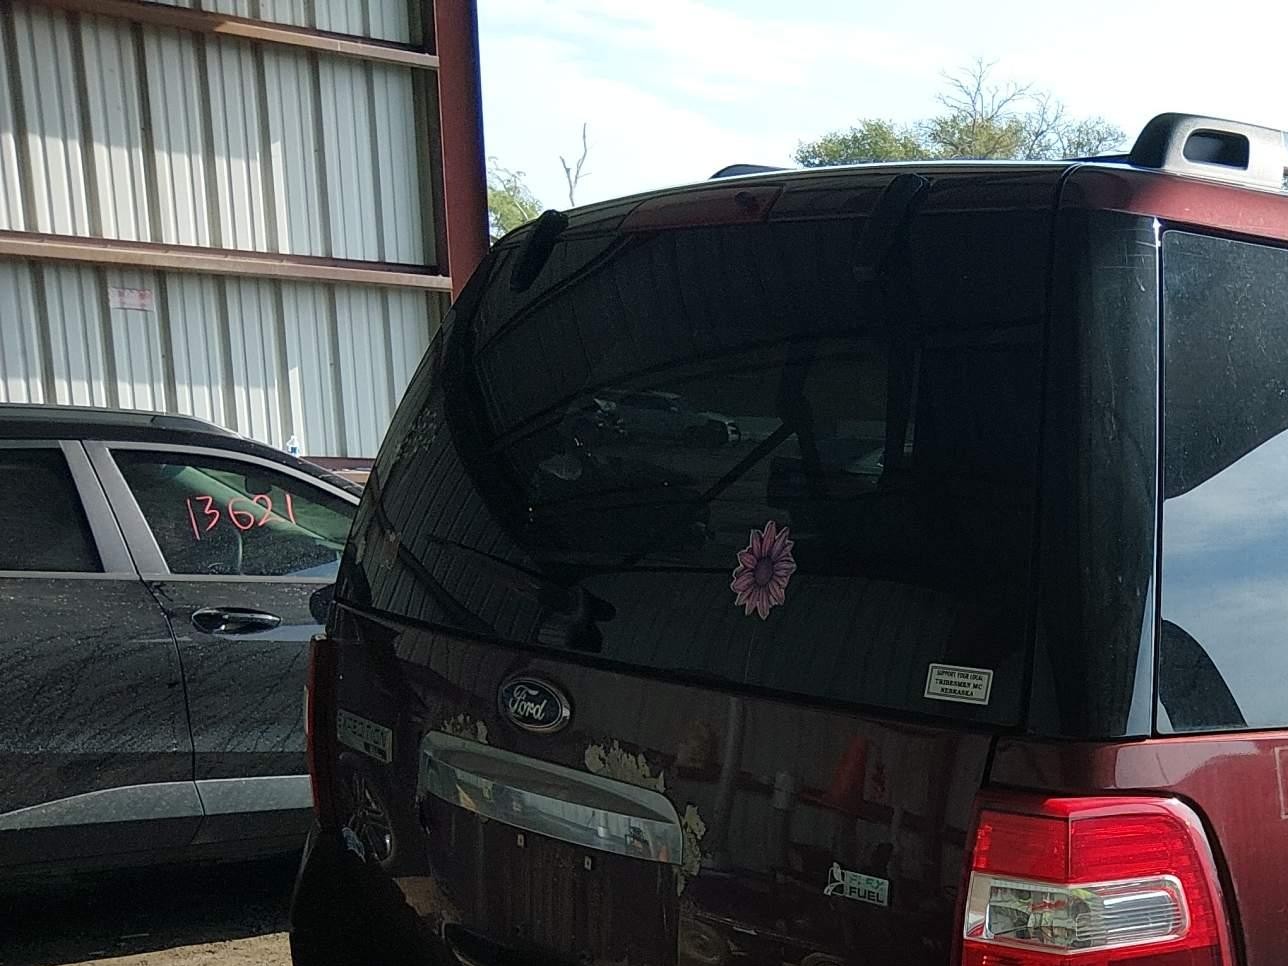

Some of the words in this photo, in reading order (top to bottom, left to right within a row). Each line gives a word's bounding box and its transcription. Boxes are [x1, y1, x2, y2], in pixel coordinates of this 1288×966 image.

[186, 494, 296, 540] 13621
[940, 687, 974, 697] NEBRASKA
[972, 682, 983, 690] MC
[509, 685, 547, 720] Ford
[848, 886, 885, 904] FUEL
